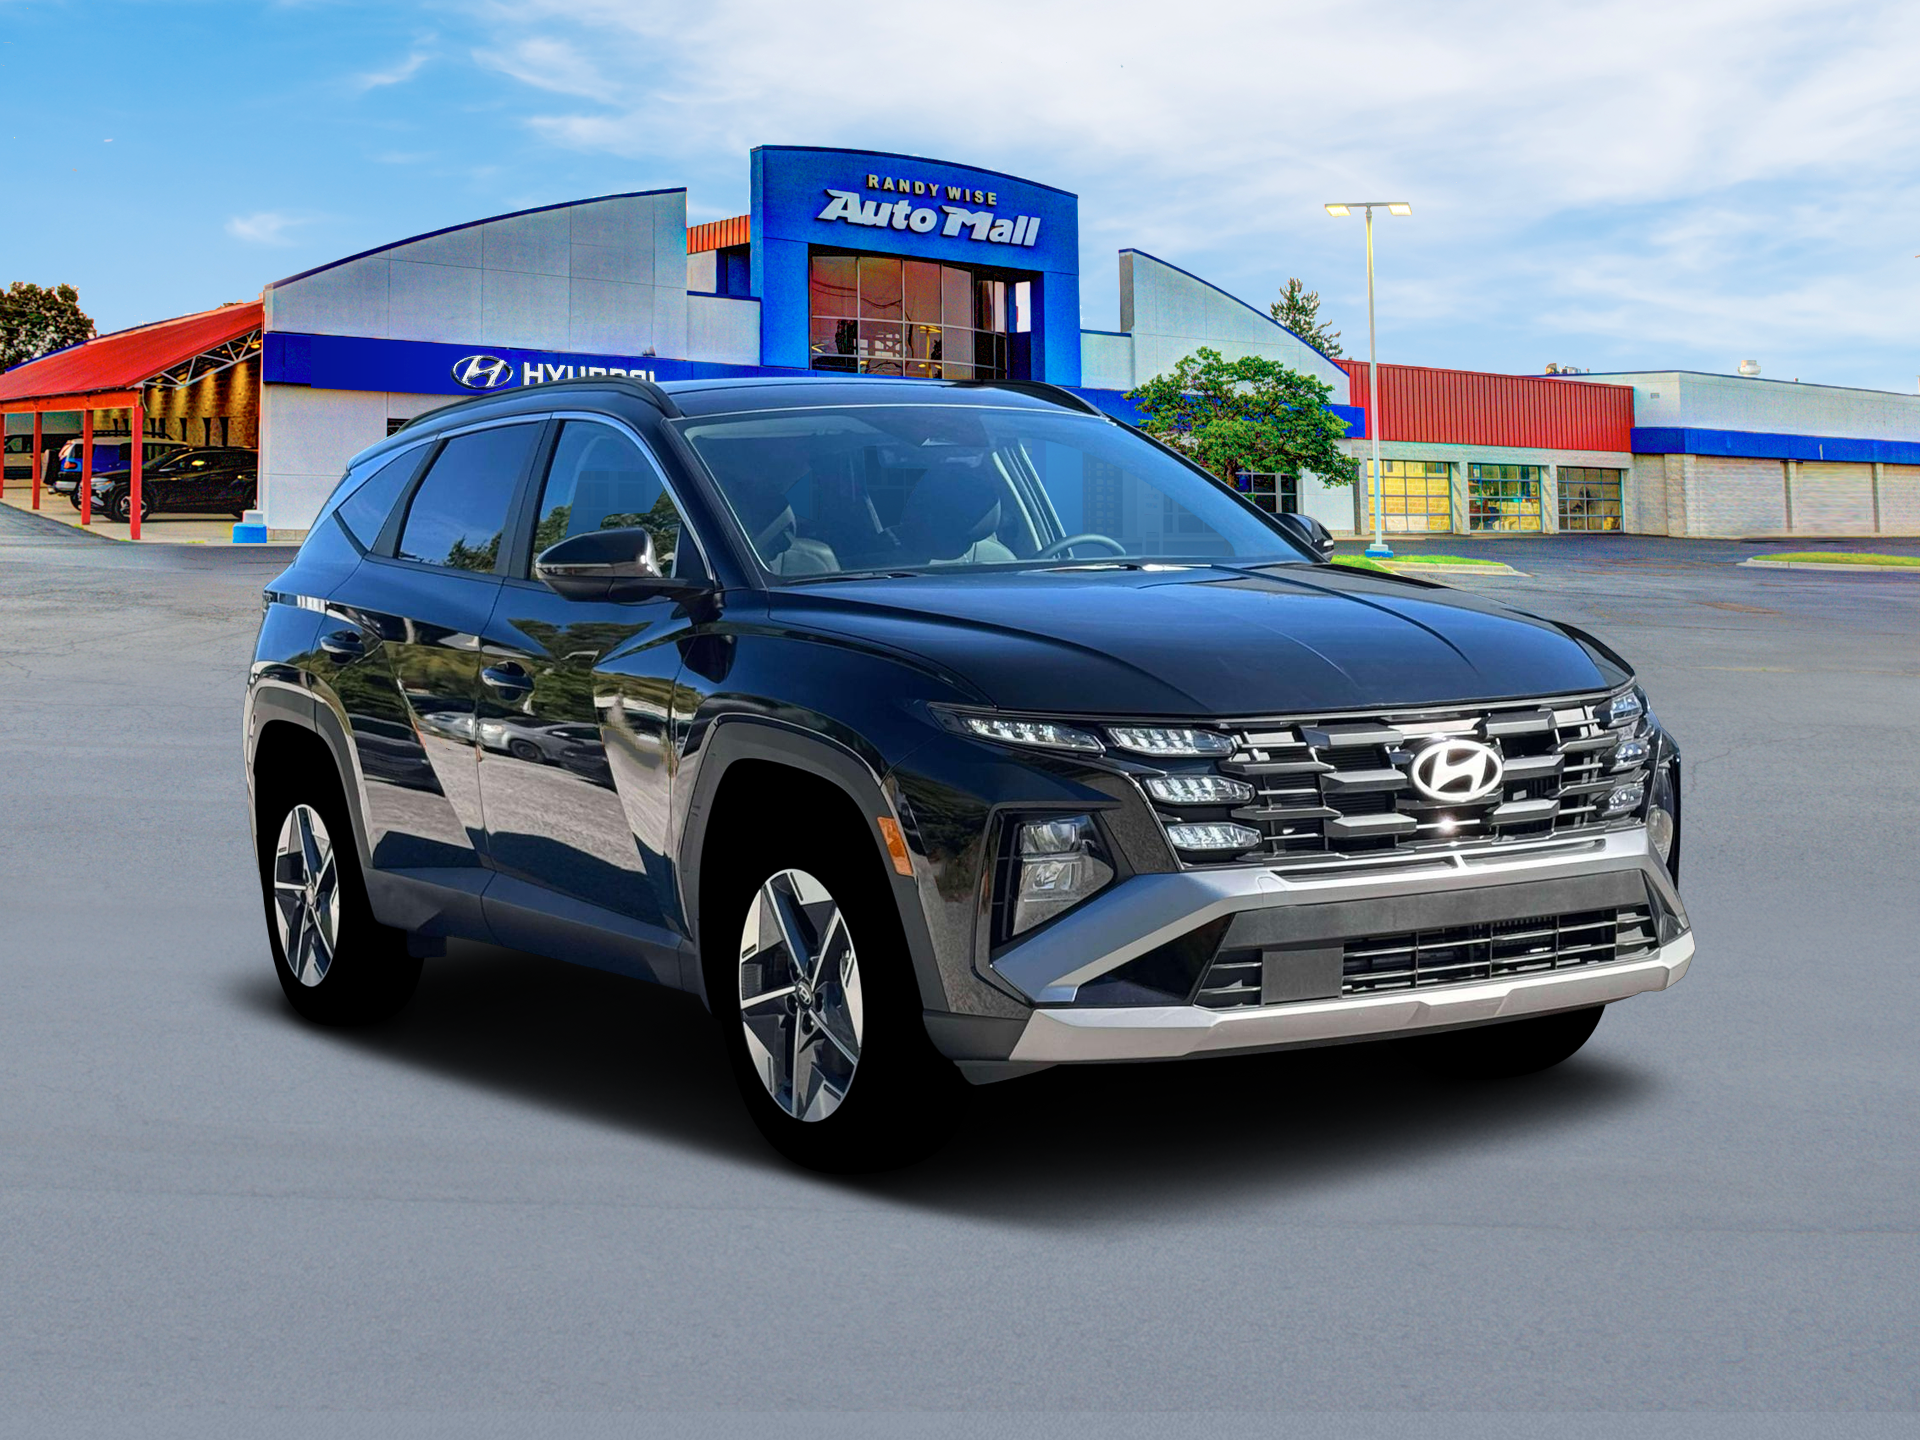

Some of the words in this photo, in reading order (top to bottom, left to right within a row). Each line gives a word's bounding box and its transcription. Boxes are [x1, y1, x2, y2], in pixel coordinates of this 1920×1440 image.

[866, 173, 939, 198] RANDY
[946, 186, 998, 206] WISE
[816, 188, 938, 233] Auto
[941, 205, 1042, 247] Mall
